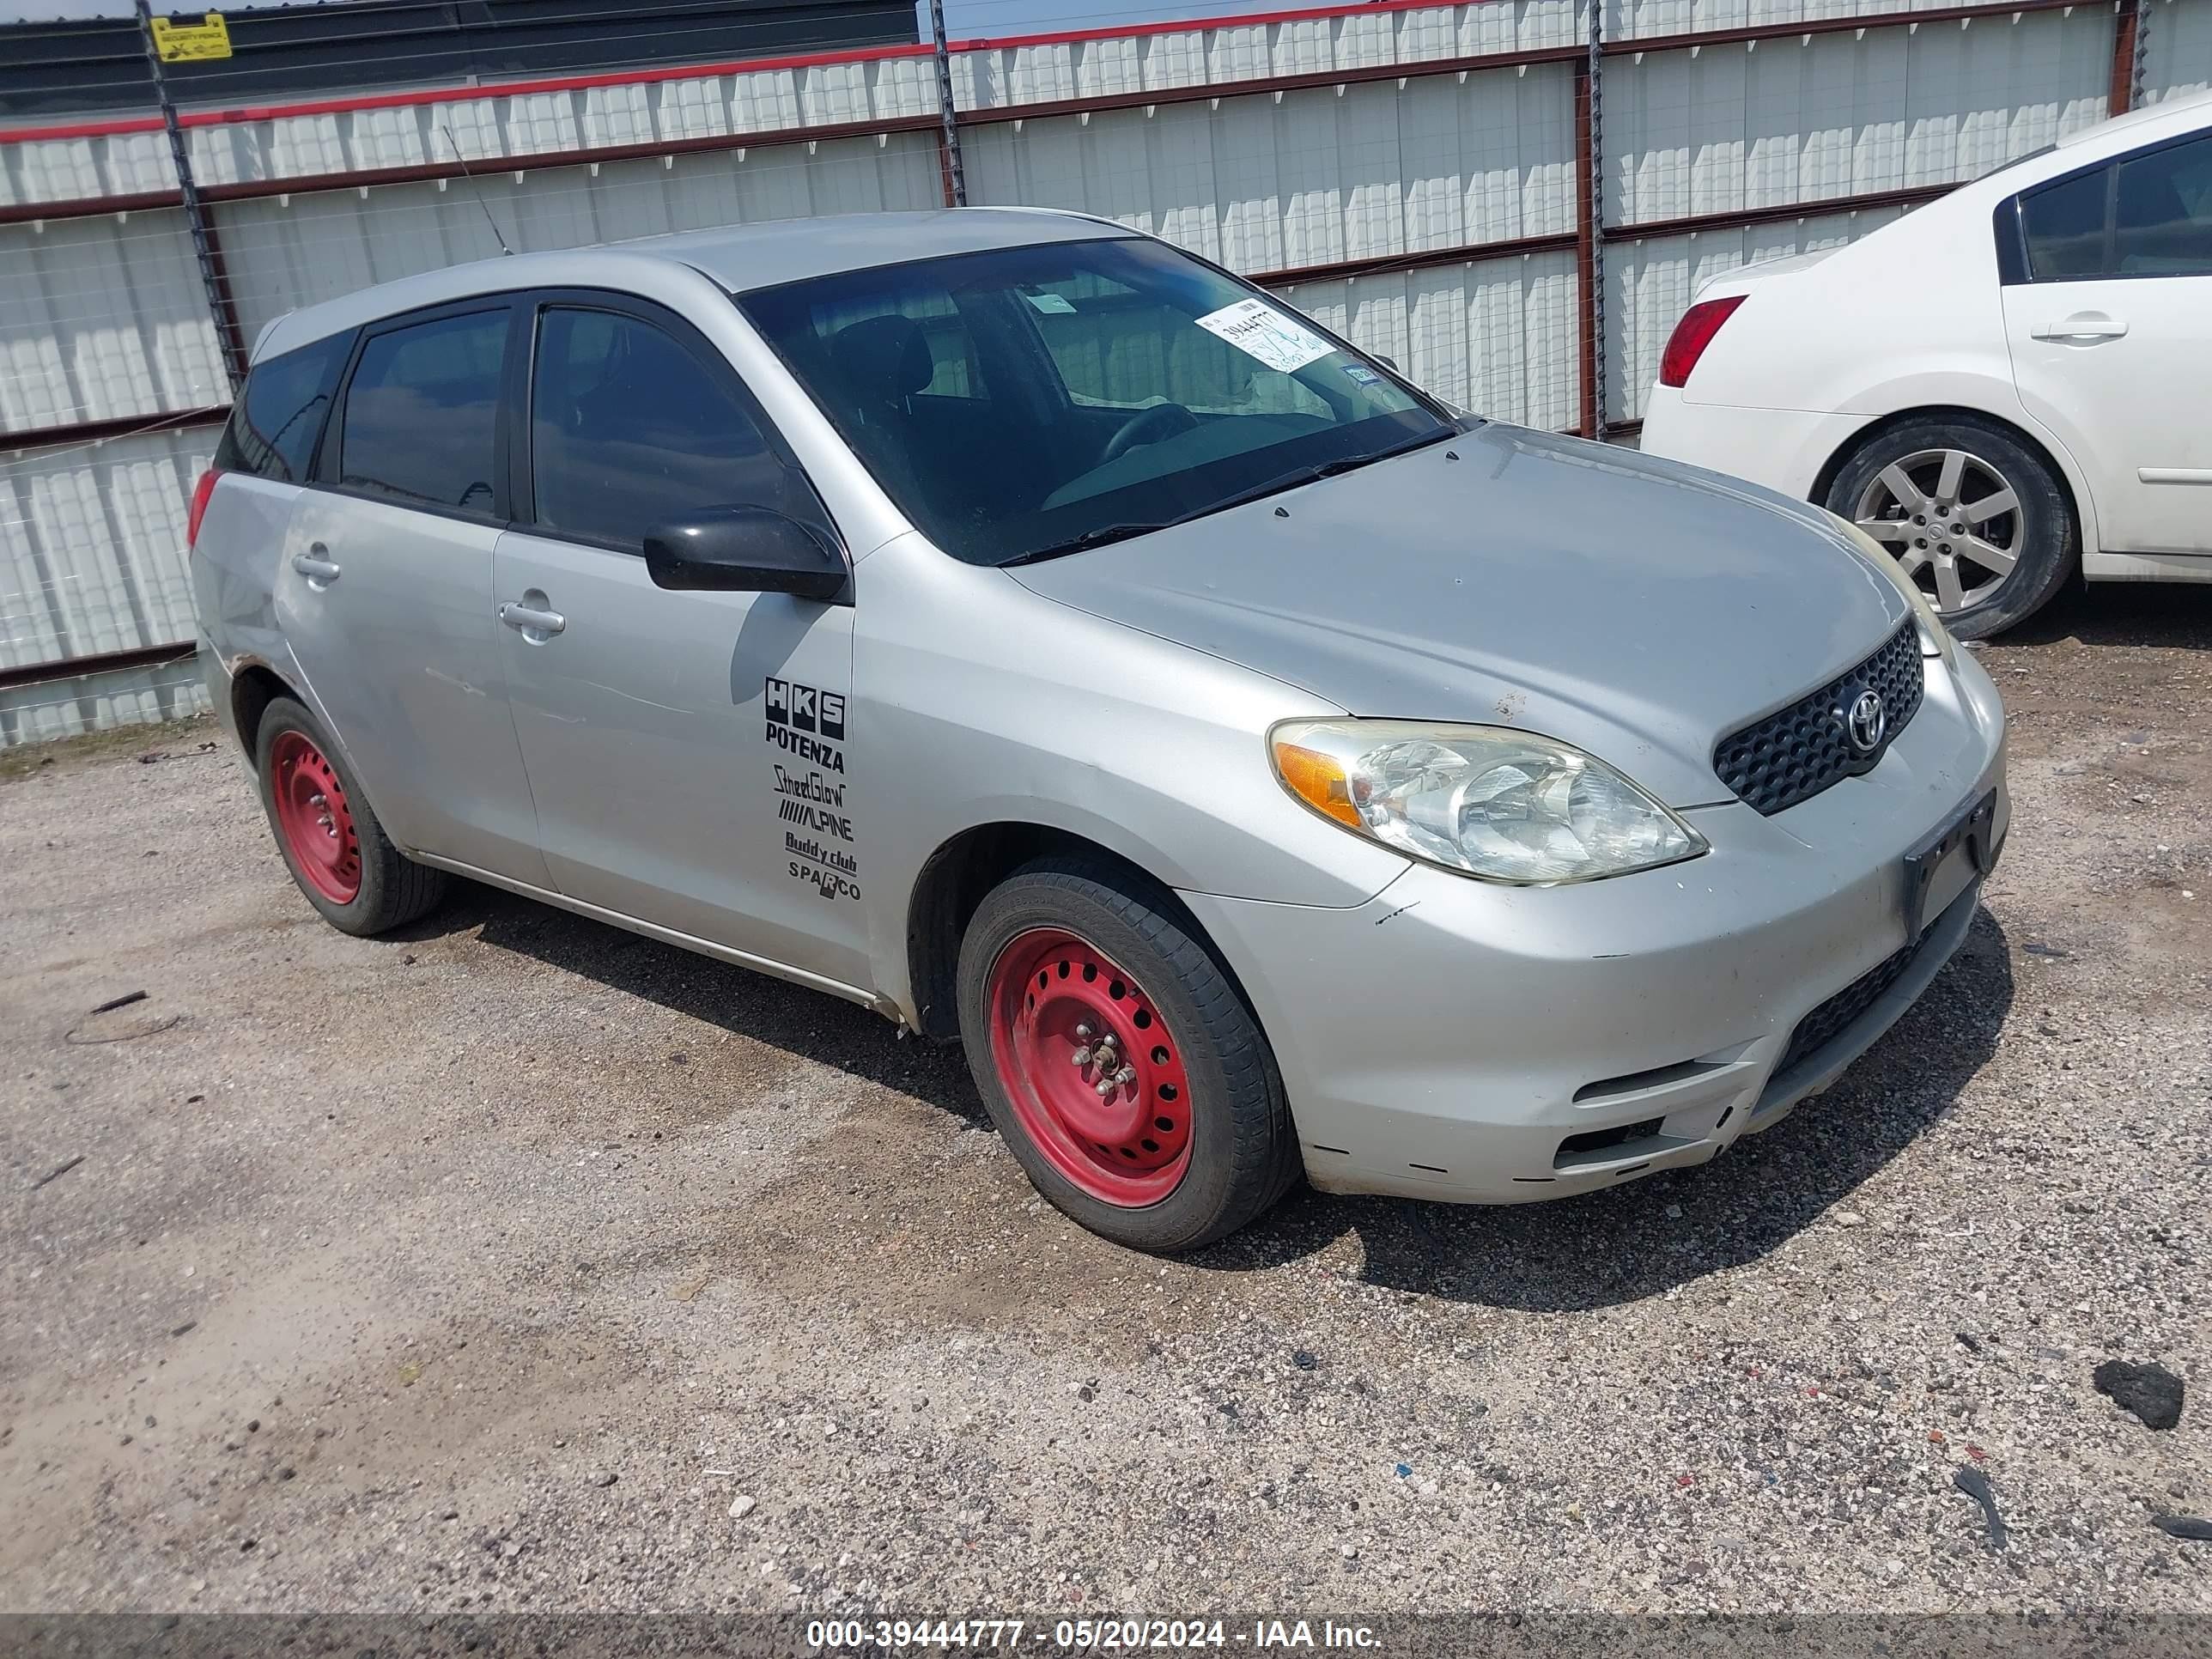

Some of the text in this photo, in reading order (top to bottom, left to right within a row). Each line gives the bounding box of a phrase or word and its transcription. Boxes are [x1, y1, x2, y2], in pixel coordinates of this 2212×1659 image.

[1223, 311, 1279, 340] 39444777
[766, 678, 845, 738] HKS
[766, 721, 845, 775] POTENZA
[774, 764, 846, 808] StreetGlow
[786, 830, 857, 872] Buddy club
[788, 861, 861, 901] SPARCO
